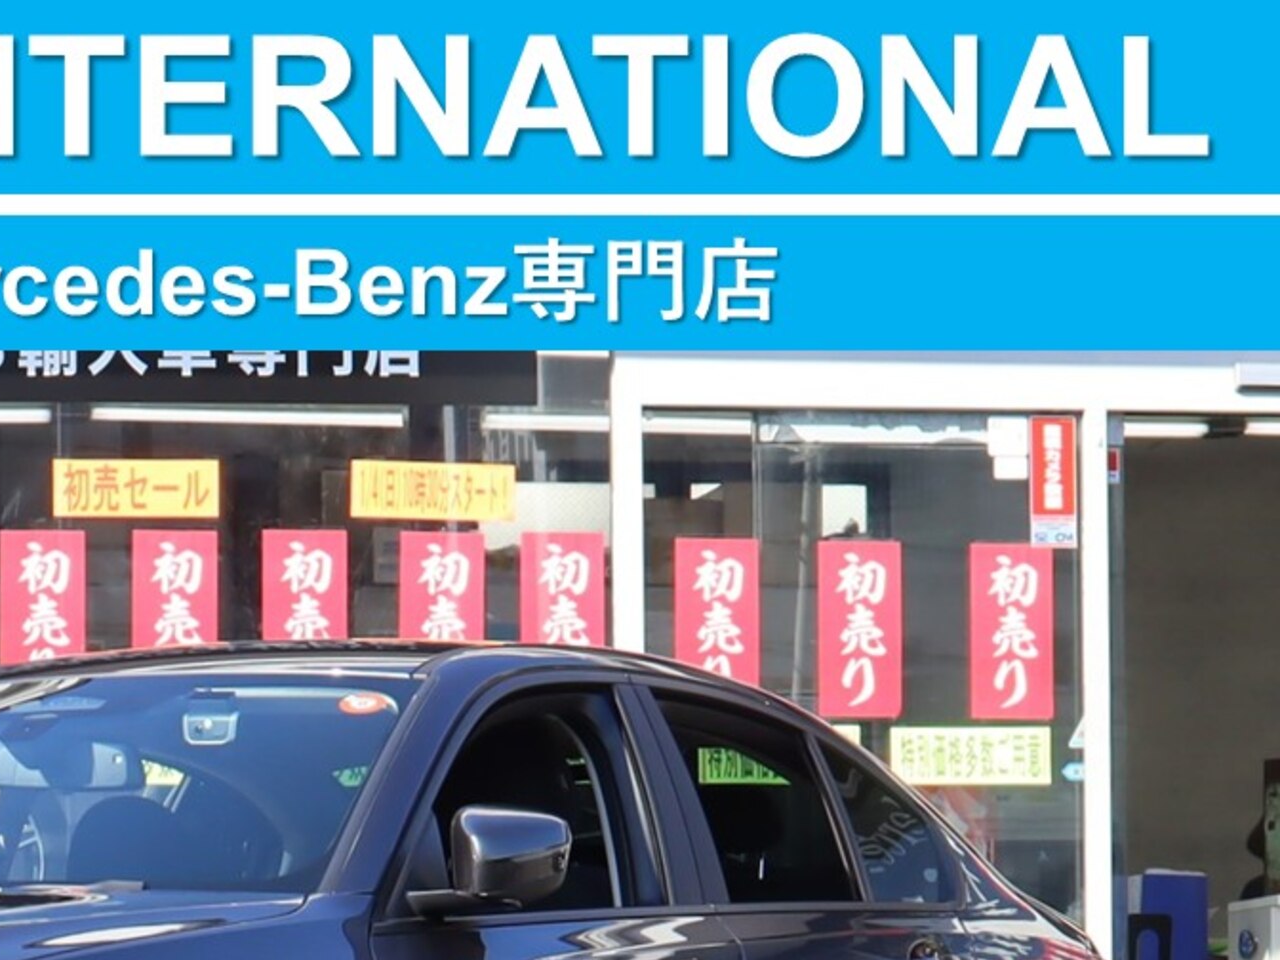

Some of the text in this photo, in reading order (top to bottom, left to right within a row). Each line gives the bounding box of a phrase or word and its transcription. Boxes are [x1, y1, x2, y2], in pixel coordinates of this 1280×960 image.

[63, 464, 211, 512] 初売セール
[18, 541, 70, 661] 初売
[151, 541, 203, 647] 初売
[281, 541, 332, 639] 初売
[419, 543, 470, 640] 初売
[538, 543, 590, 647] 初売
[836, 552, 886, 706] 初売り
[988, 554, 1038, 708] 初売り
